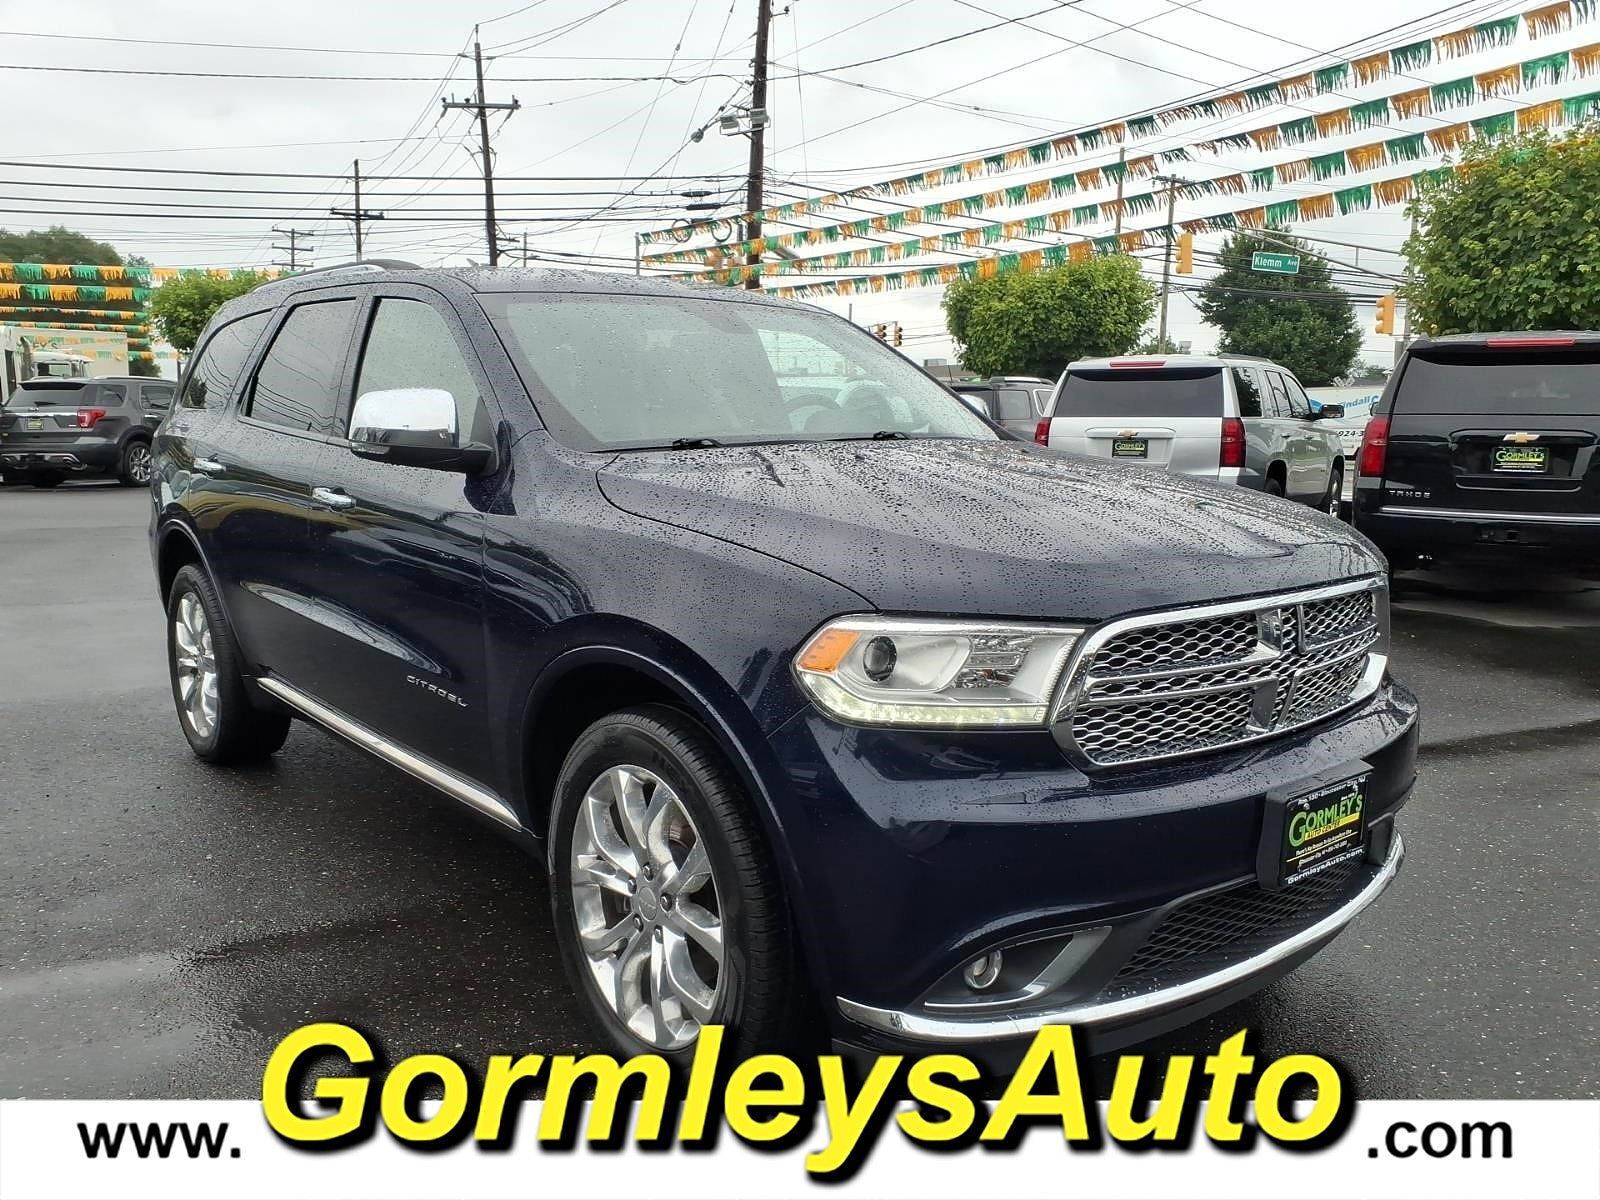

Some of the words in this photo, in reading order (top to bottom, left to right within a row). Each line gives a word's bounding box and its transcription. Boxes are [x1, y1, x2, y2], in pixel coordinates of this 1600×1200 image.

[1254, 256, 1282, 268] Klemm
[1389, 490, 1431, 499] TAHOE
[406, 675, 469, 708] CITADEL
[1289, 794, 1363, 847] GORMLEY'S
